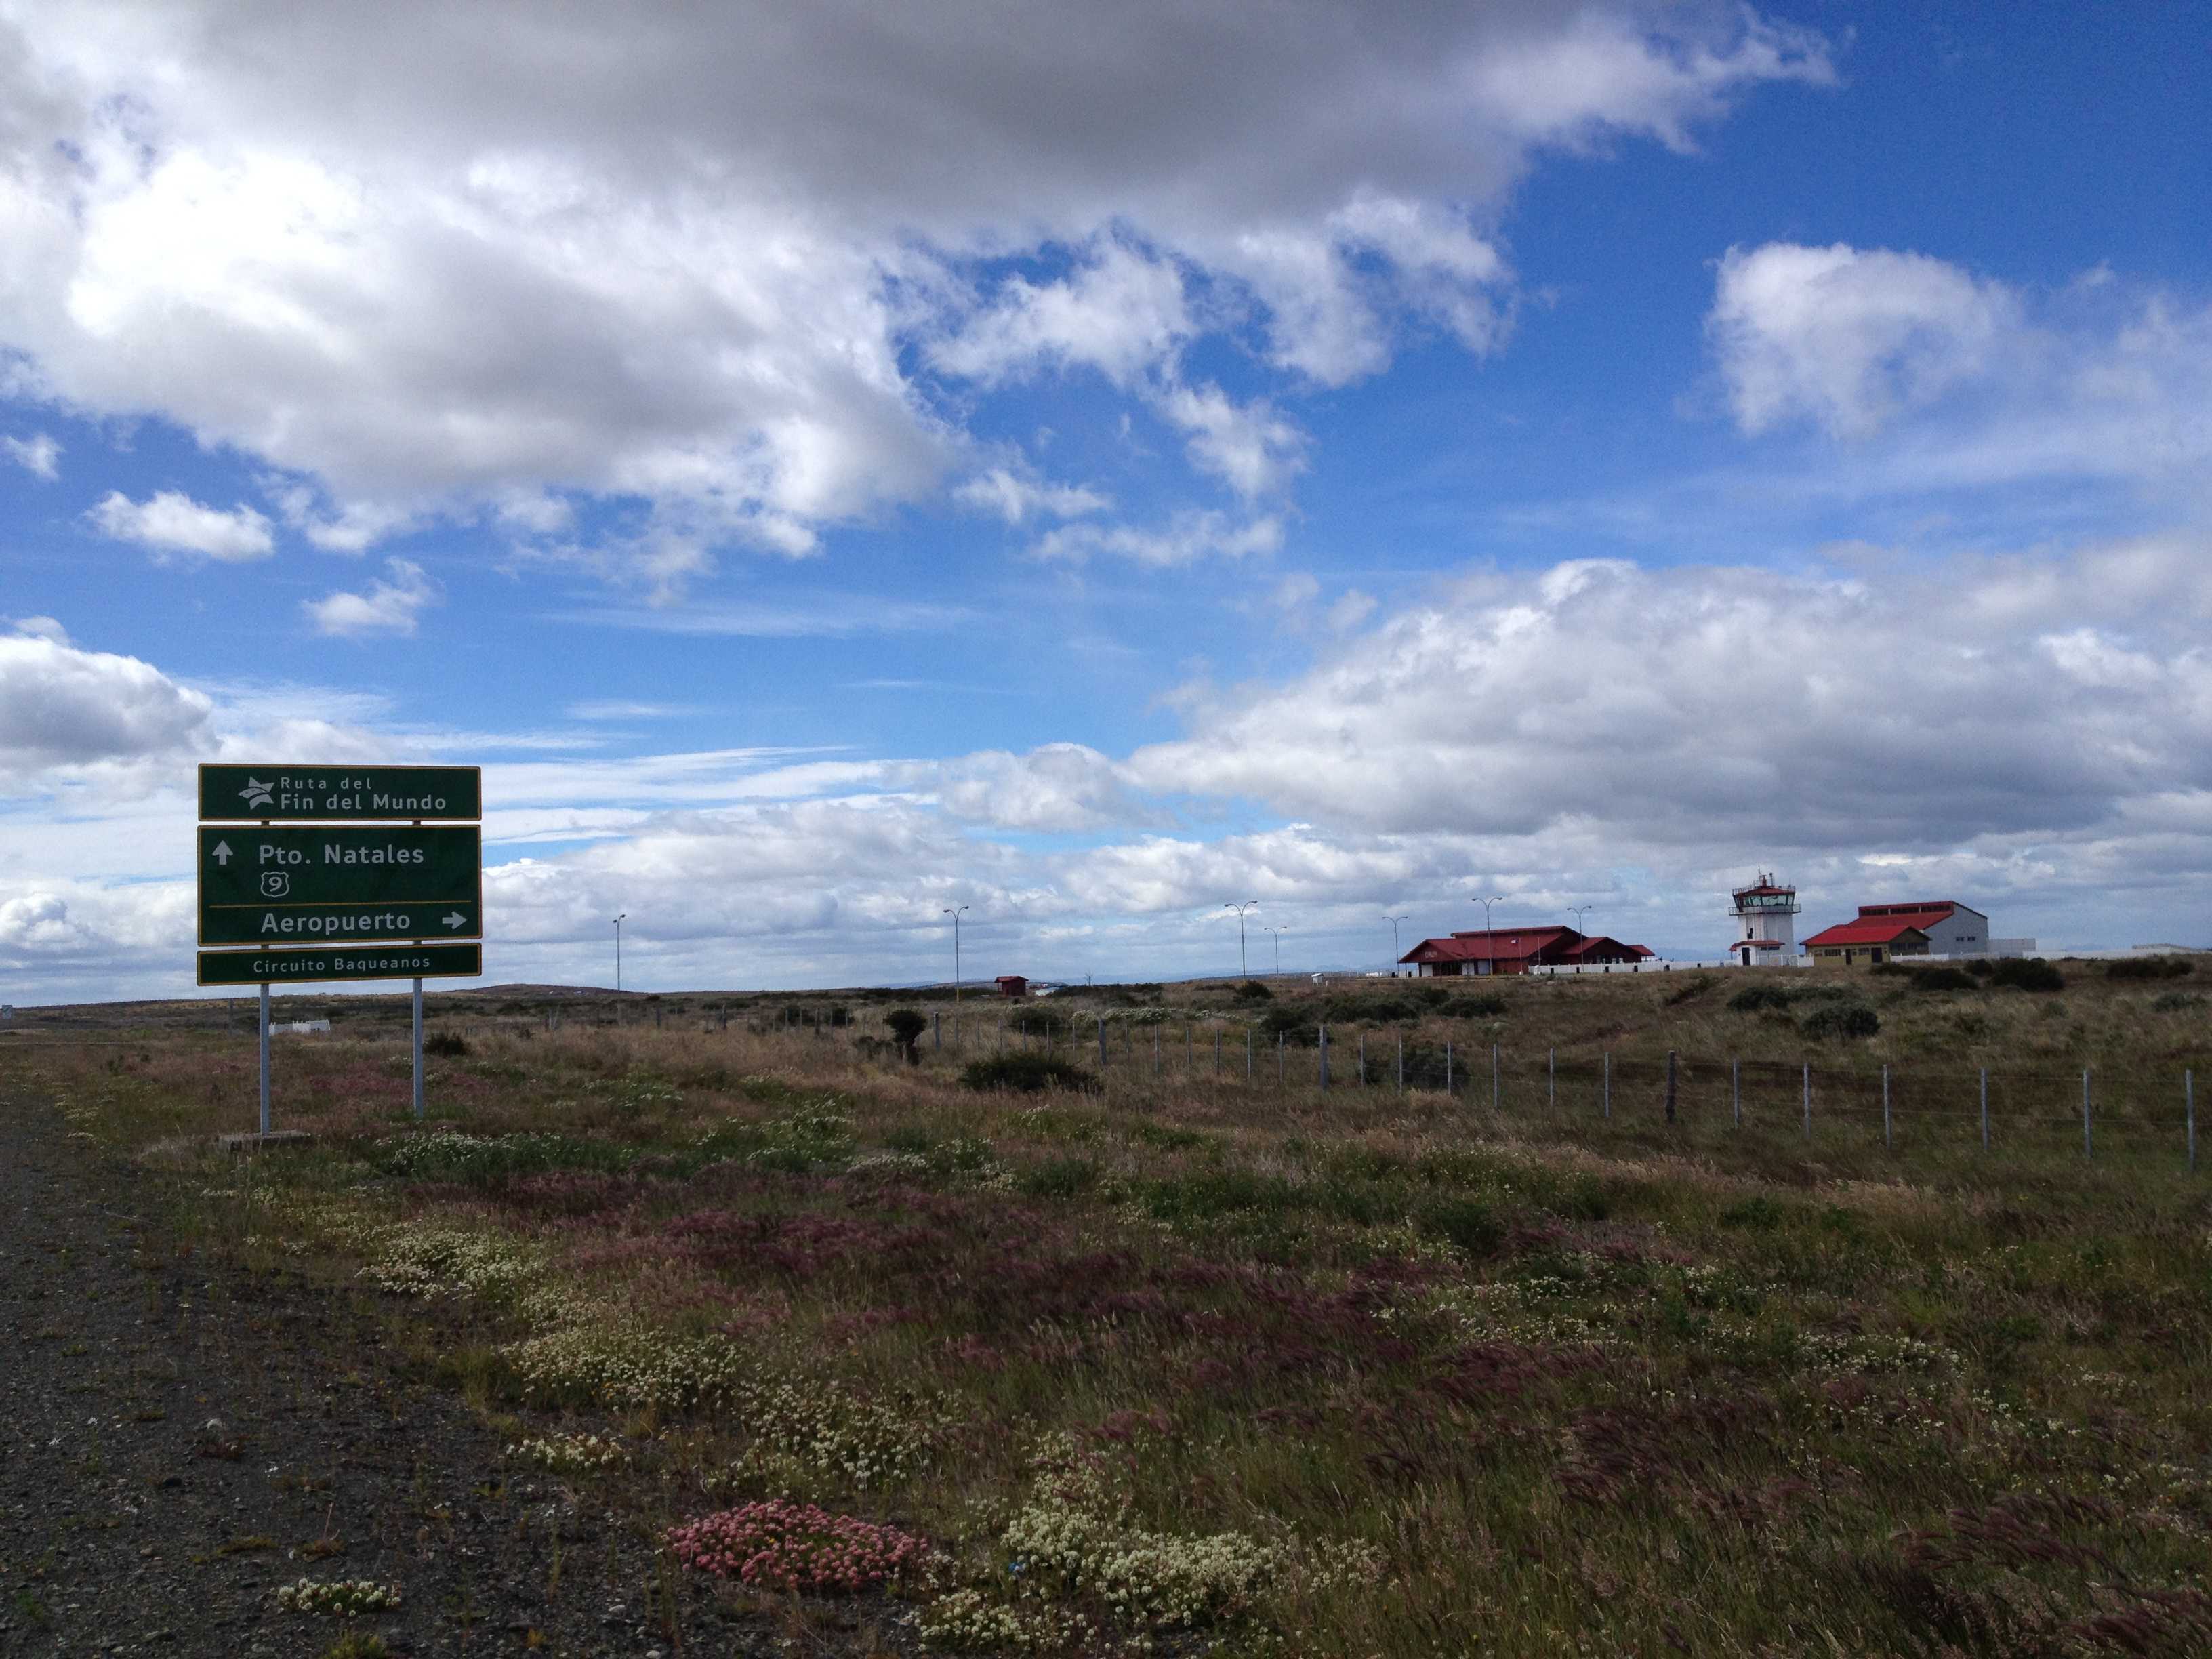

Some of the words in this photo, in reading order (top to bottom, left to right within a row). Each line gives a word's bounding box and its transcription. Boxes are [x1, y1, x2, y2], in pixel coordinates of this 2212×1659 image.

[281, 777, 327, 790] Ruta
[340, 777, 371, 790] del
[281, 793, 314, 810] Fin
[326, 794, 362, 810] del
[373, 794, 446, 810] Mundo
[260, 844, 311, 864] Pto.
[325, 844, 424, 864] Natales
[268, 876, 283, 892] 9
[261, 912, 410, 935] Aeropuerto
[253, 959, 325, 973] Circuito
[335, 958, 430, 972] Baqueanos
